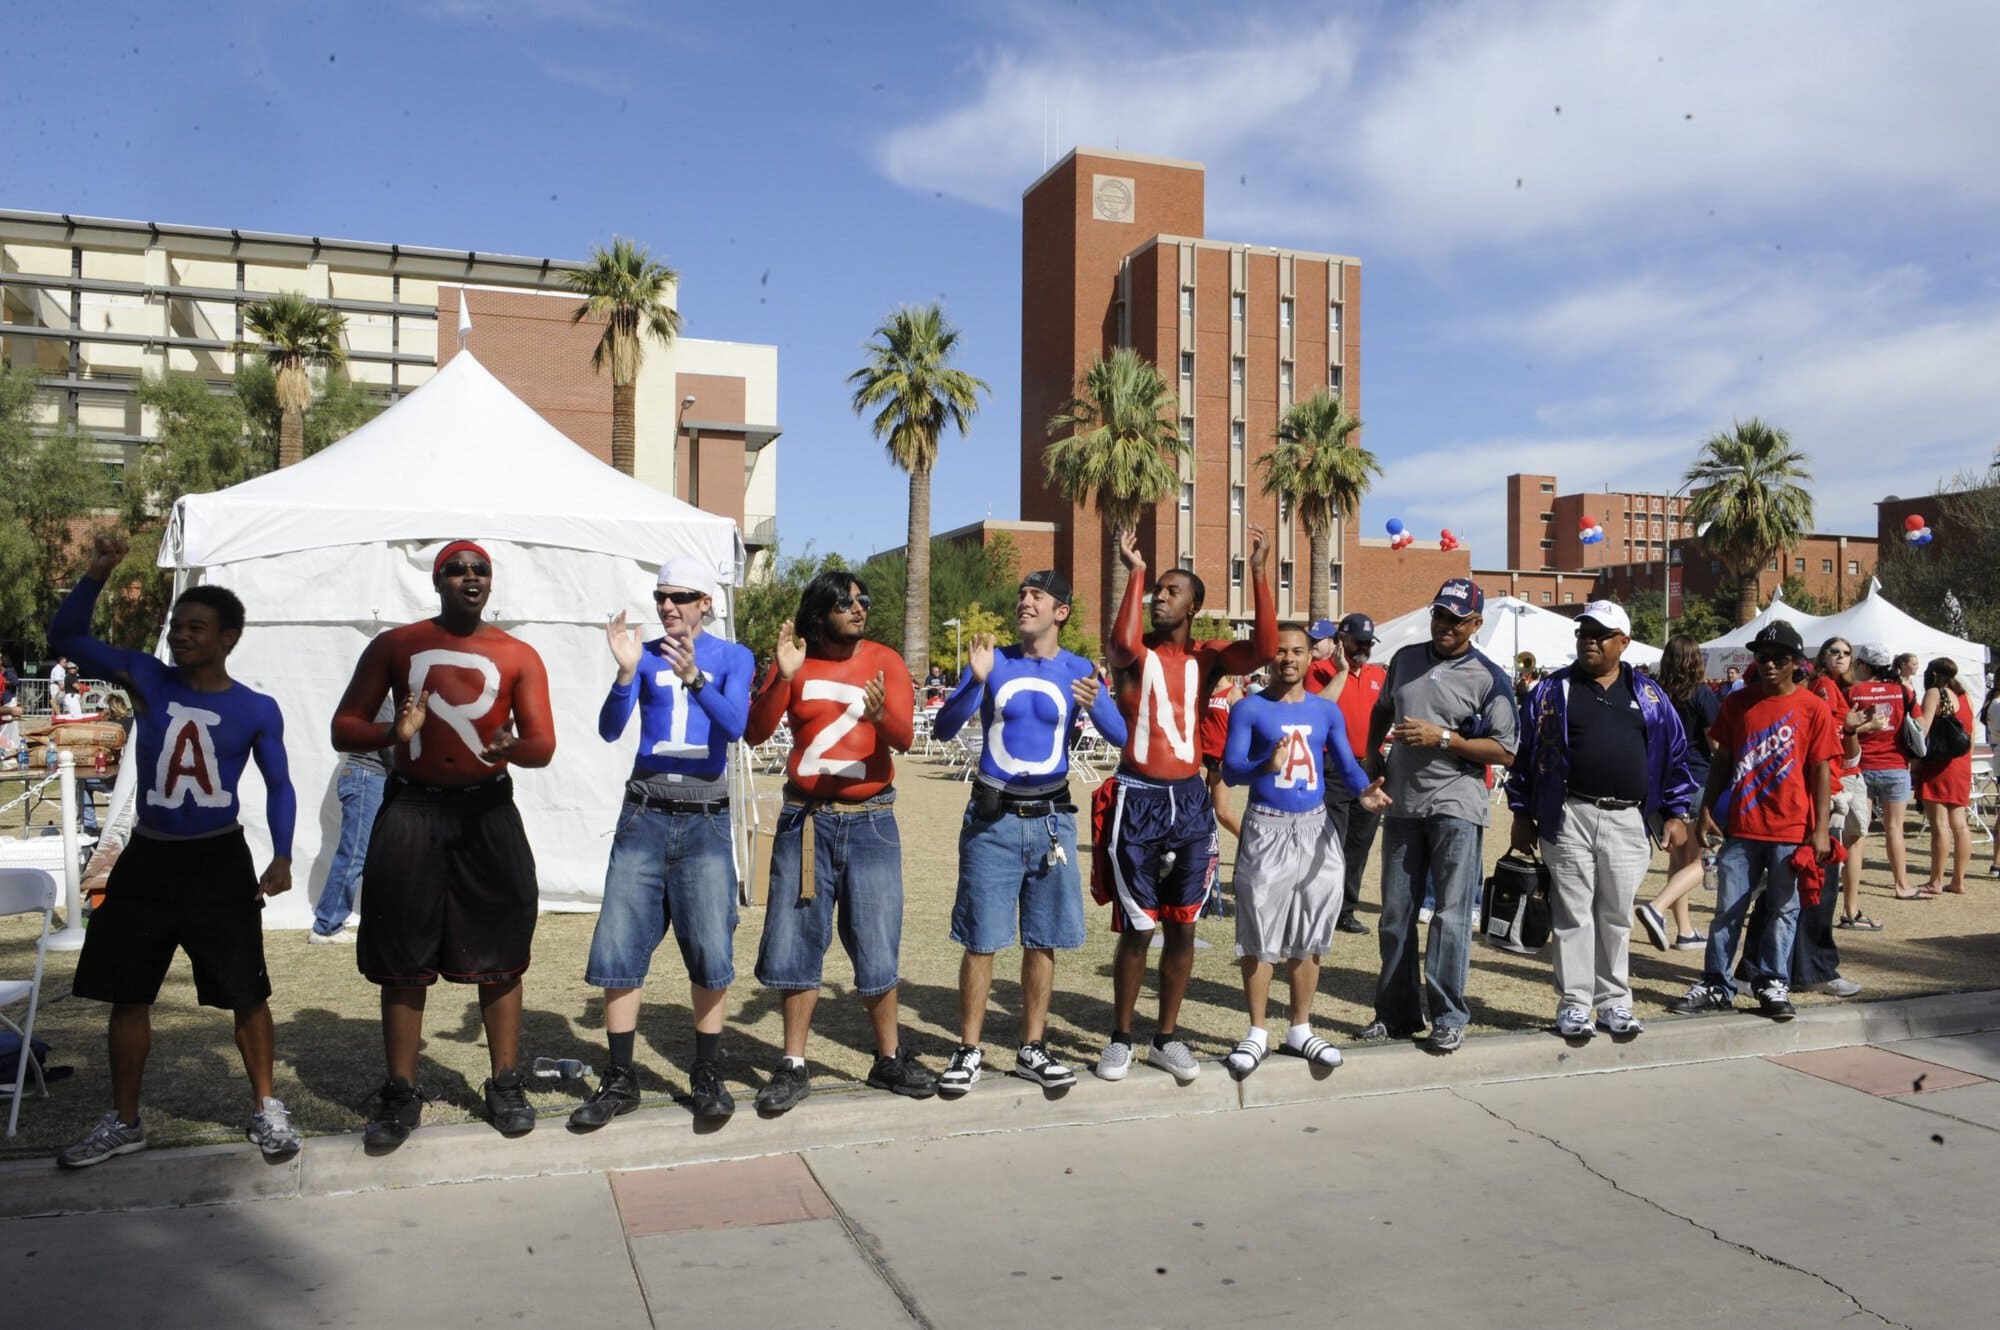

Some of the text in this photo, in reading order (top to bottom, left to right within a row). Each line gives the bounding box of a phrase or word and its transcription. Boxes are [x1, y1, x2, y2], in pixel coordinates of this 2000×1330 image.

[147, 702, 232, 808] A
[408, 649, 502, 766] R
[651, 670, 713, 759] I
[797, 679, 866, 779] Z
[988, 676, 1068, 777] O
[1133, 649, 1199, 765] N
[1274, 725, 1319, 791] A
